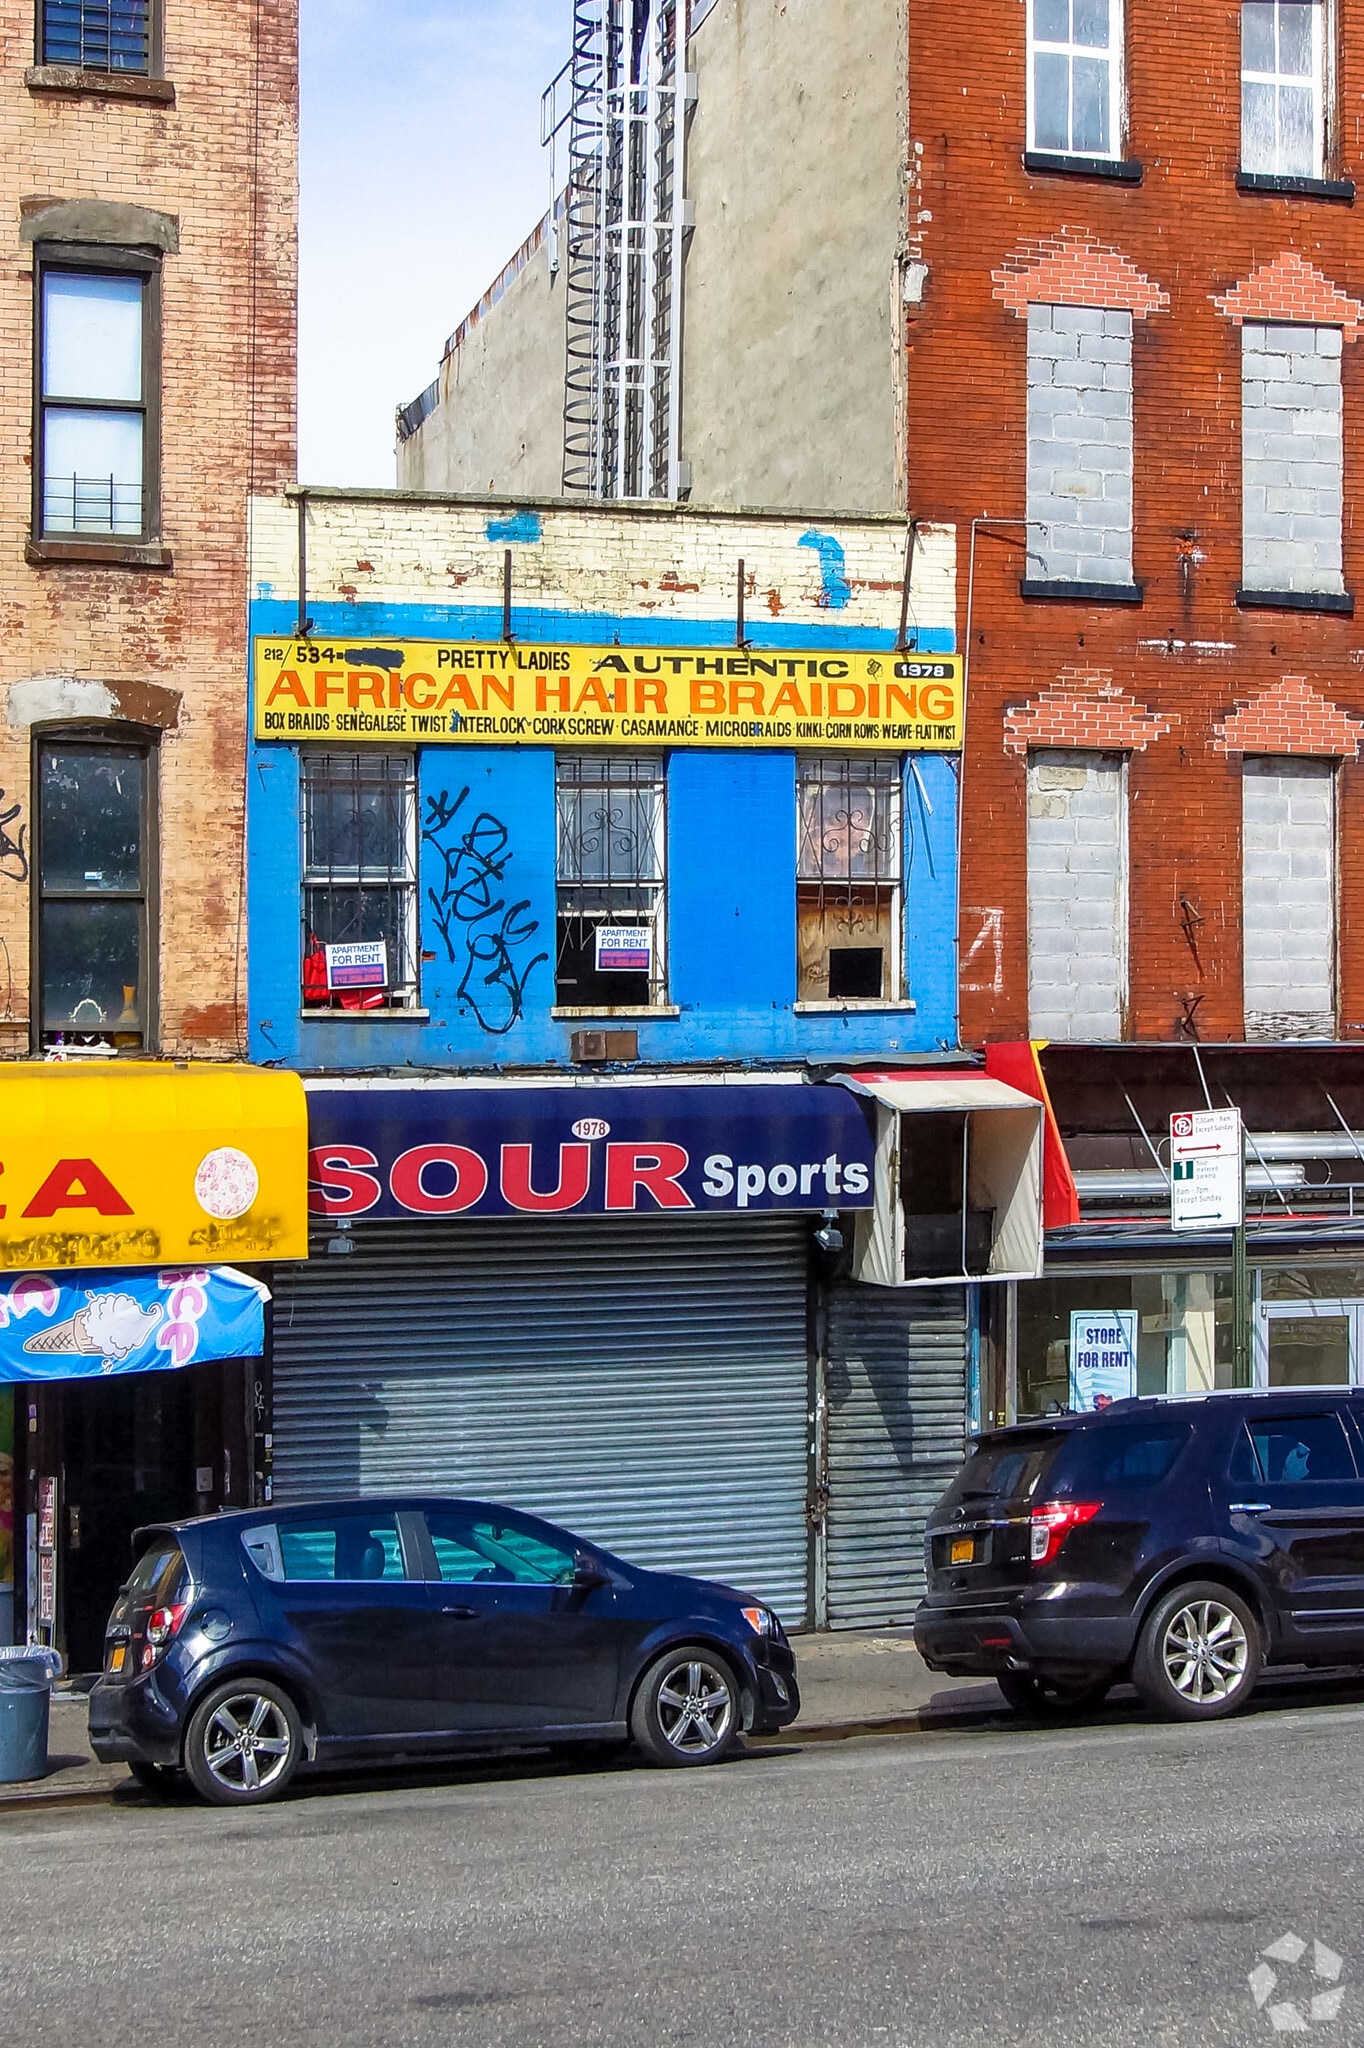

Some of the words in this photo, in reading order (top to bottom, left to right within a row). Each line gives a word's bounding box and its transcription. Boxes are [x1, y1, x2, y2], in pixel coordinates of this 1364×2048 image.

[438, 649, 510, 670] PRETTY
[517, 650, 571, 671] LADIES
[592, 654, 850, 678] AUTHENTIC
[900, 664, 946, 677] 1978
[264, 670, 515, 711] AFRICAN
[535, 675, 669, 714] HAIR
[689, 679, 954, 721] BRAIDING
[264, 712, 285, 730] BOX
[288, 712, 330, 731] BRAIDS
[411, 715, 448, 733] TWIST
[453, 715, 526, 734] NTERLOCK
[621, 719, 699, 737] CASAMANCE
[705, 720, 792, 738] MICROBRAIDS
[825, 722, 851, 739] CORN
[854, 723, 880, 740] ROWS
[882, 724, 912, 740] WEAVE
[915, 724, 932, 740] FLAT
[933, 724, 956, 740] TWIST
[601, 938, 620, 947] FOR
[623, 938, 648, 947] RENT
[332, 955, 352, 965] FOR
[354, 953, 381, 964] RENT
[575, 1120, 606, 1136] 1978
[308, 1140, 696, 1217] SOUR
[702, 1152, 870, 1208] Sports
[1086, 1328, 1122, 1345] STORE
[1078, 1351, 1100, 1368] FOR
[1101, 1351, 1130, 1368] RENT
